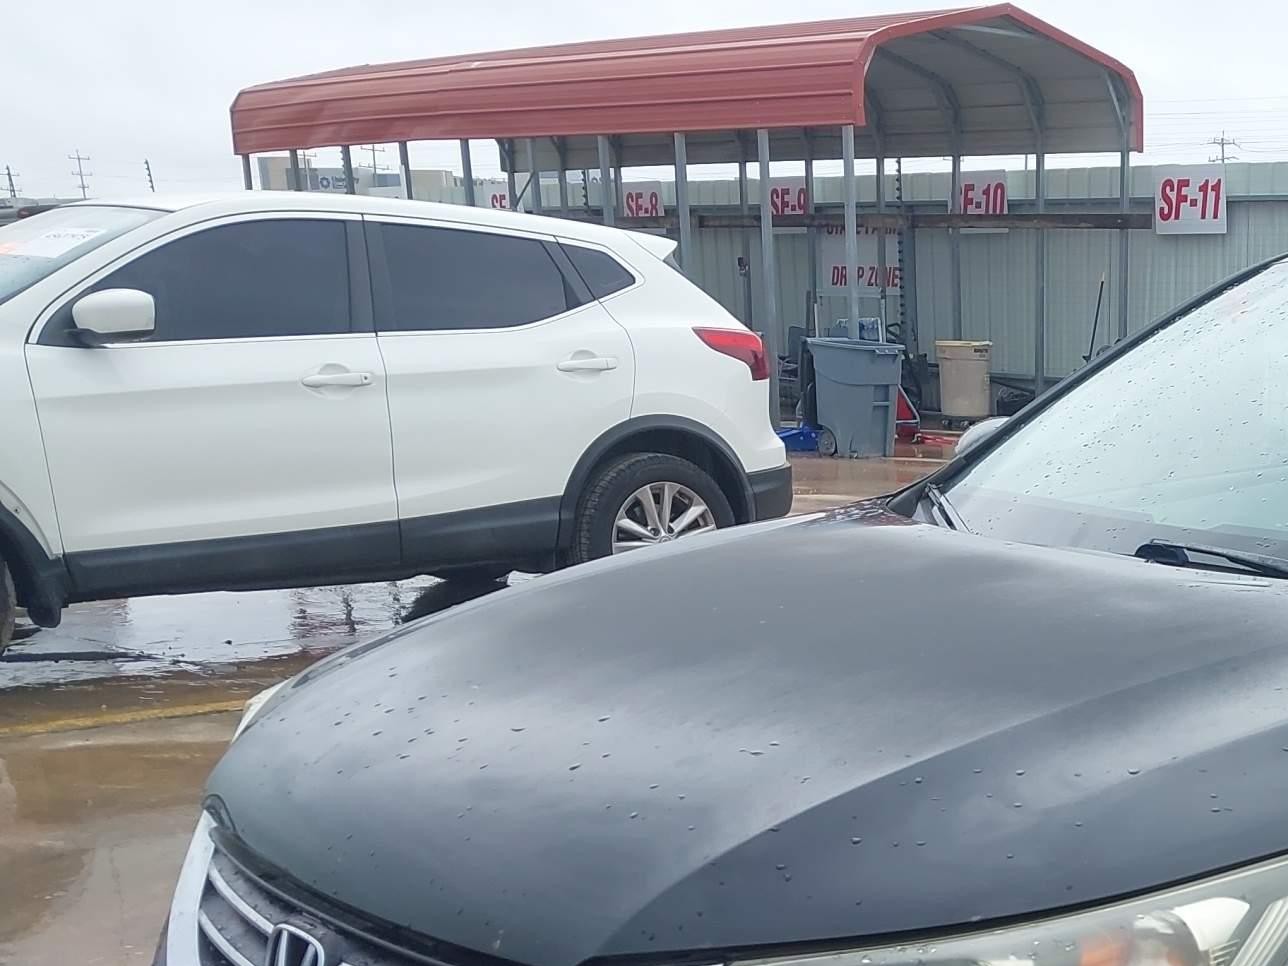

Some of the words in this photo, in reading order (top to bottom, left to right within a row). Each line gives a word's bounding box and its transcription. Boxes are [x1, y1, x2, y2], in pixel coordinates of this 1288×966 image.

[625, 191, 659, 217] SF-8
[960, 182, 1006, 215] F-10
[1158, 178, 1222, 222] SF-11
[831, 265, 865, 287] DRP
